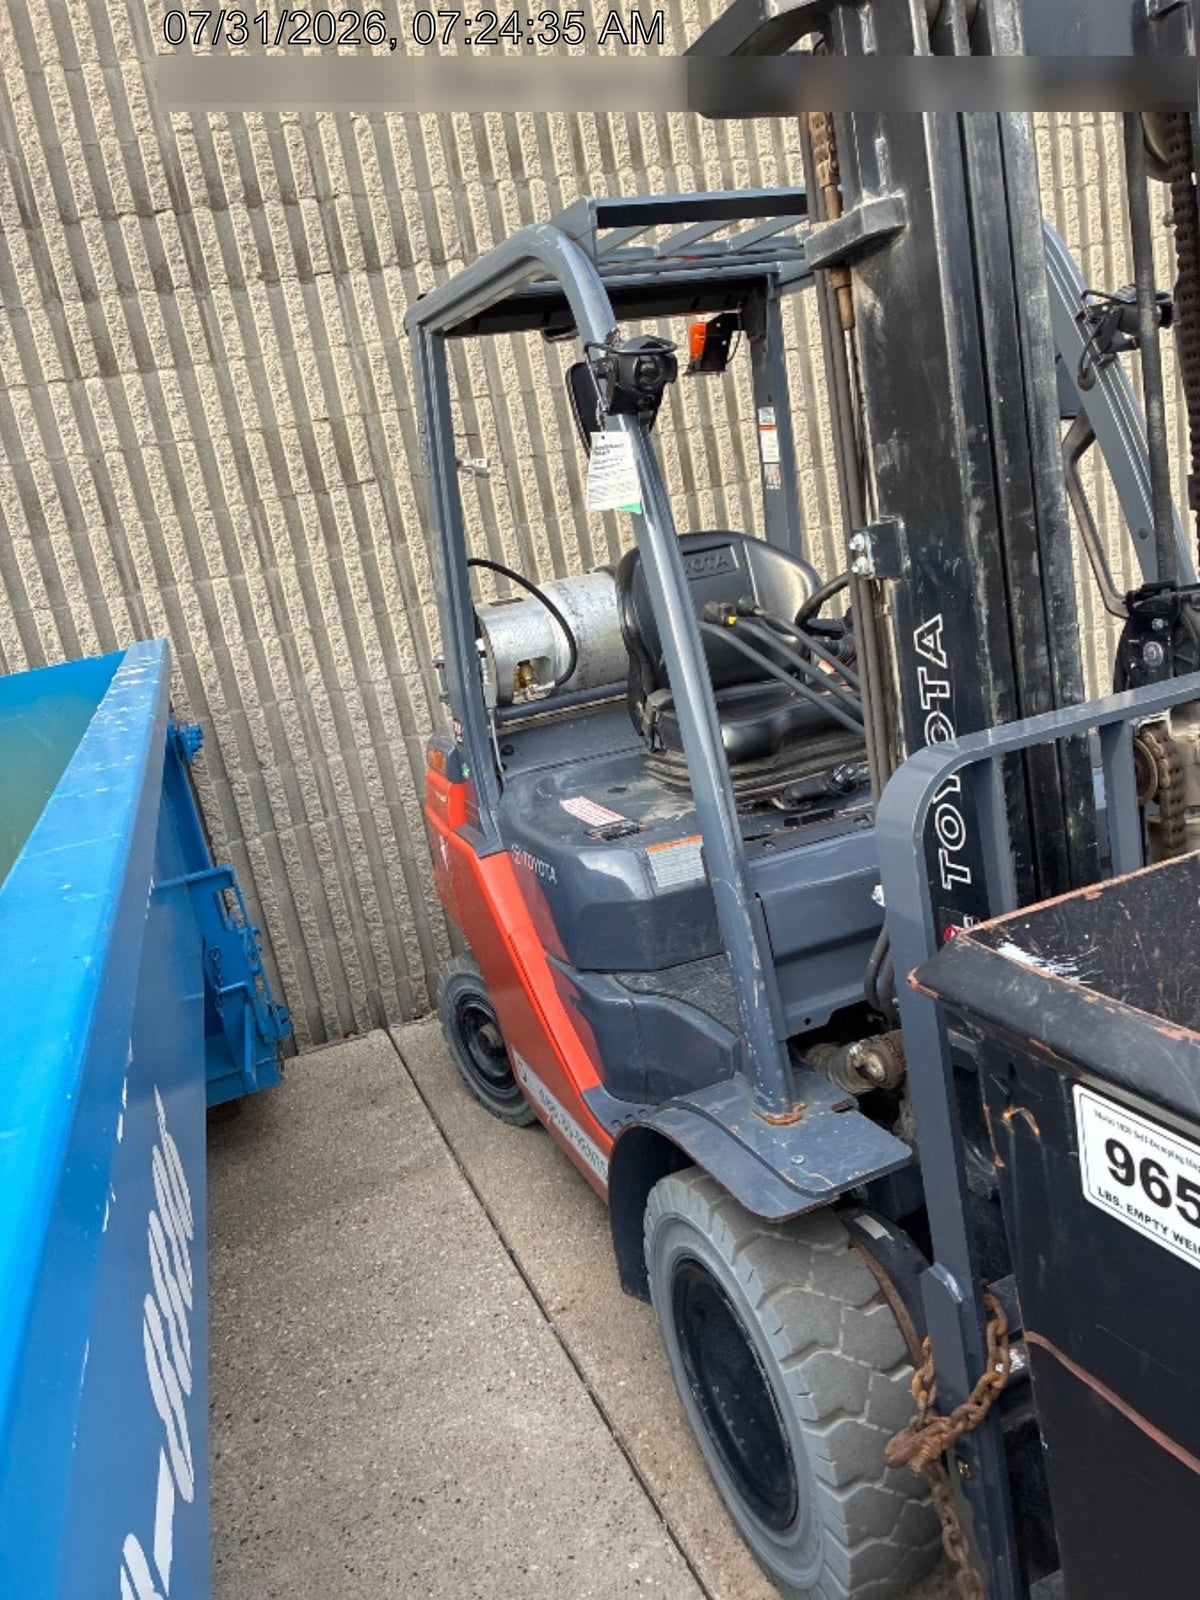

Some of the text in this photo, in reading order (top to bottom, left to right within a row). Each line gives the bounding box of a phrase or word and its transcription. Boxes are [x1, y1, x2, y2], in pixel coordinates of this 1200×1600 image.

[1097, 1185, 1200, 1256] LBS. EMPTY WEI
[1105, 1138, 1200, 1229] 965
